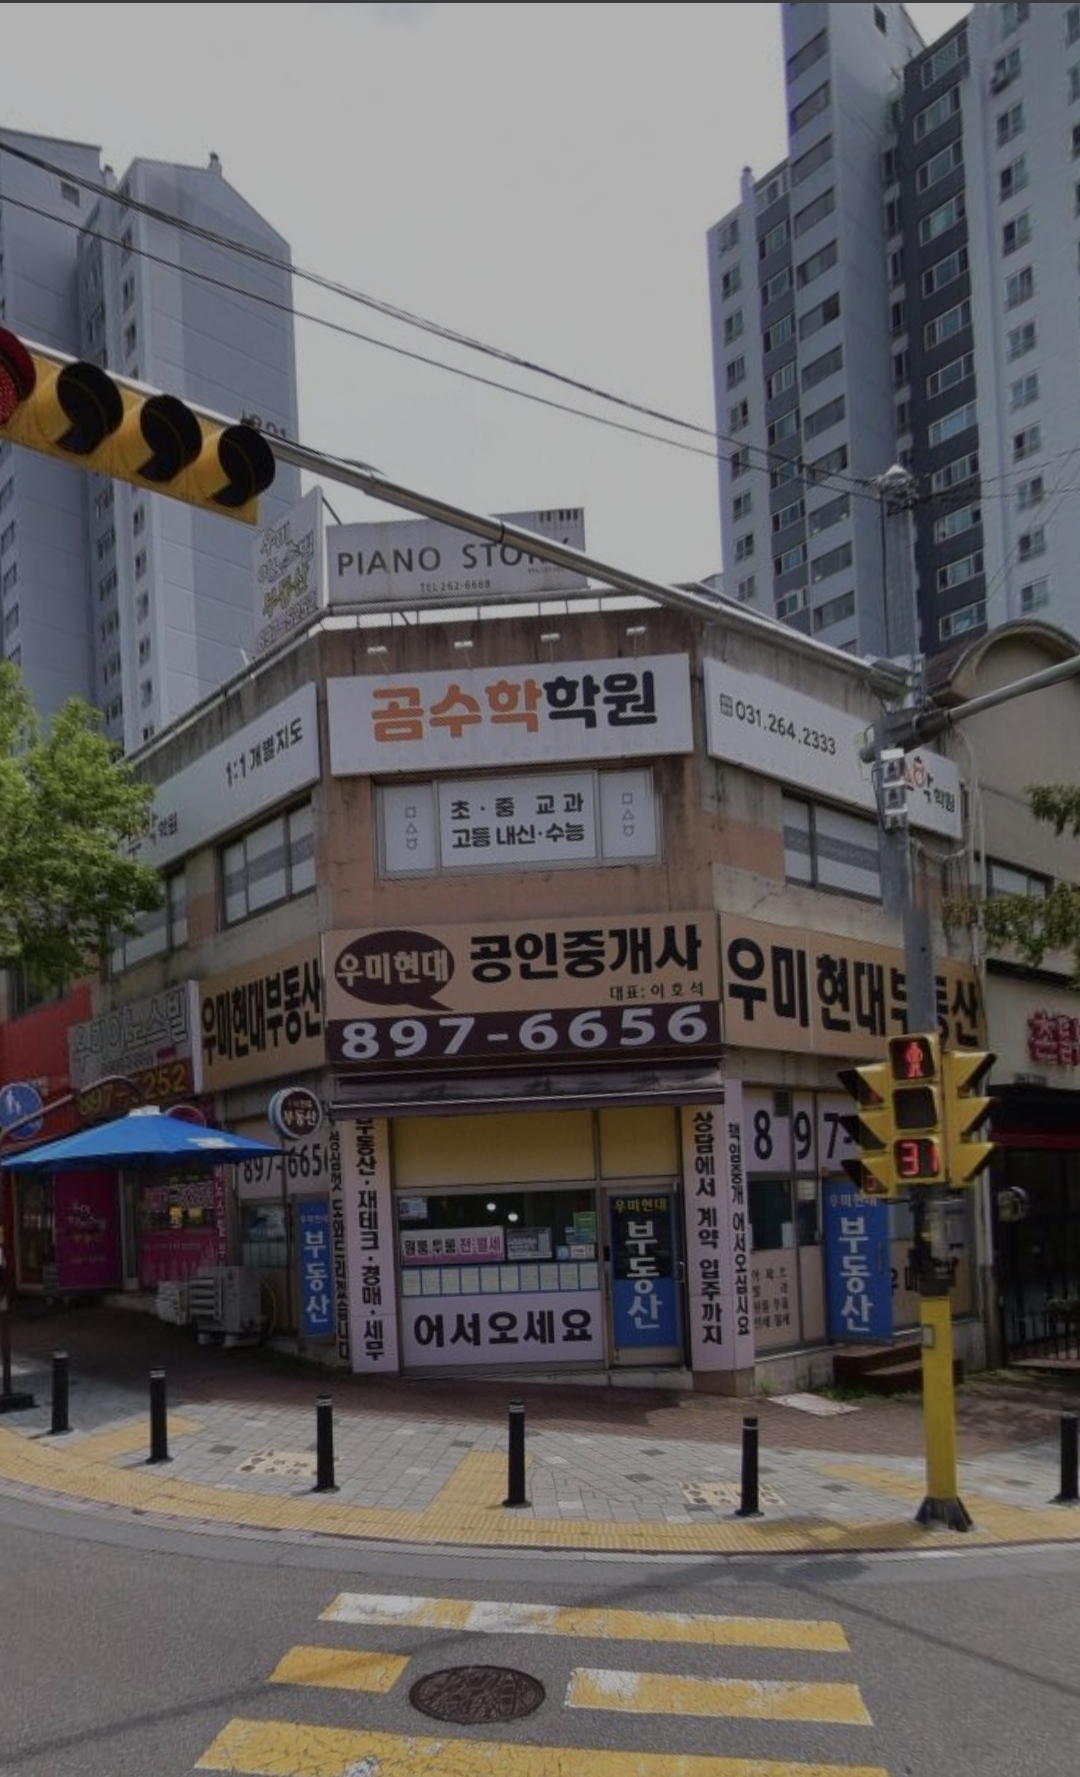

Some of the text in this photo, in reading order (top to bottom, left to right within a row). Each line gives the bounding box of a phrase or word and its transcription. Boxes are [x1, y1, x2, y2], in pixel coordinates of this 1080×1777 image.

[338, 537, 569, 577] PIANO STO
[371, 670, 657, 742] 곰수학학원
[735, 701, 836, 755] 031.264.2333
[226, 717, 303, 786] 1:1 개별지도
[536, 793, 584, 815] 교과
[452, 822, 584, 848] 고등 내신·수능
[335, 924, 702, 988] 우미현대 공인중개사
[201, 959, 321, 1065] 우미현대부동산
[341, 1003, 708, 1061] 897-6656
[79, 1063, 186, 1116] 897-252
[284, 1109, 317, 1127] 부동산
[902, 1142, 939, 1176] 31
[614, 1198, 667, 1213] 우미현대
[693, 1111, 723, 1345] 상담에서 계약 입주까지
[304, 1230, 330, 1324] 부동산
[625, 1220, 664, 1330] 부동산
[838, 1216, 874, 1332] 부동산
[414, 1309, 592, 1348] 어서오세요
